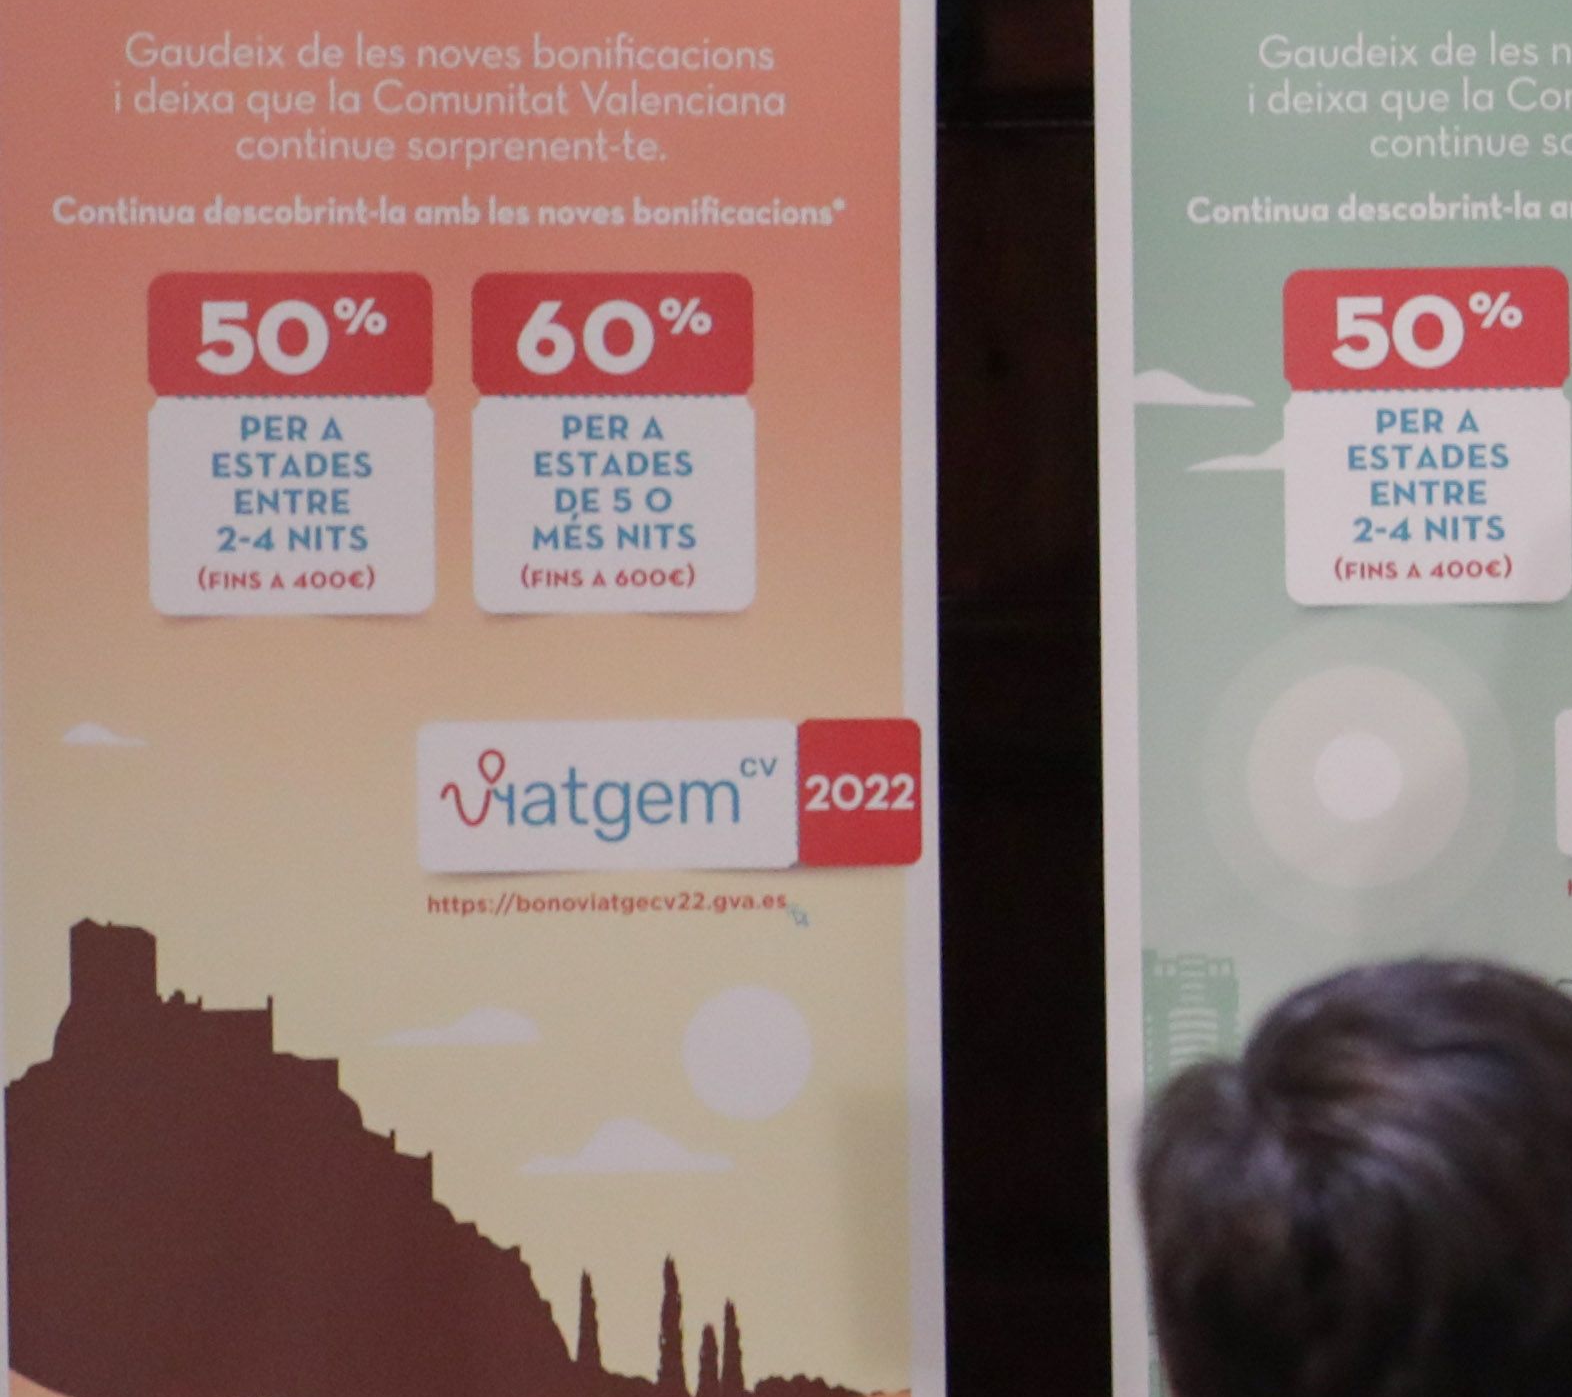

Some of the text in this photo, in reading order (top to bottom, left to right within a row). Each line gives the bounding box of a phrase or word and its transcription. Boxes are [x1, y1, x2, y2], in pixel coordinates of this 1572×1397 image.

[126, 31, 774, 70] Gaudeix de les noves bonificacions
[1259, 31, 1417, 69] Gaudeix
[1431, 30, 1476, 66] de
[1490, 30, 1538, 66] les
[115, 76, 786, 122] i deixa que la Comunitat Valenciana
[1249, 84, 1254, 113] i
[1268, 78, 1367, 114] deixa
[1381, 90, 1449, 121] que
[1463, 75, 1493, 111] la
[236, 128, 666, 169] continue sorprenent-te.
[1370, 125, 1529, 158] continue
[53, 196, 195, 225] Continua
[204, 195, 406, 225] descobrint-la
[415, 195, 481, 224] amb
[489, 196, 530, 225] les
[538, 206, 625, 225] noves
[1188, 197, 1329, 223] Continua
[1338, 191, 1540, 222] descobrint-la
[197, 298, 386, 375] 50%
[517, 298, 712, 374] 60%
[1333, 292, 1522, 369] 50%
[241, 416, 342, 441] PER A
[563, 415, 663, 440] PER A
[1377, 408, 1479, 433] PER A
[212, 452, 372, 478] ESTADES
[534, 451, 693, 477] ESTADES
[1348, 443, 1509, 470] ESTADES
[235, 489, 349, 514] ENTRE
[556, 488, 599, 513] DE
[614, 488, 632, 513] 5
[1371, 480, 1486, 506] ENTRE
[218, 525, 368, 551] 2-4 NITS
[533, 508, 696, 550] MÉS NITS
[1354, 516, 1505, 542] 2-4 NITS
[198, 566, 375, 590] (FINS A 400€)
[521, 564, 695, 588] (FINS A 600€)
[1335, 555, 1512, 580] (FINS A 400€)
[806, 774, 914, 810] 2022
[428, 892, 787, 916] https://bonoviatgecv22.gva.es
